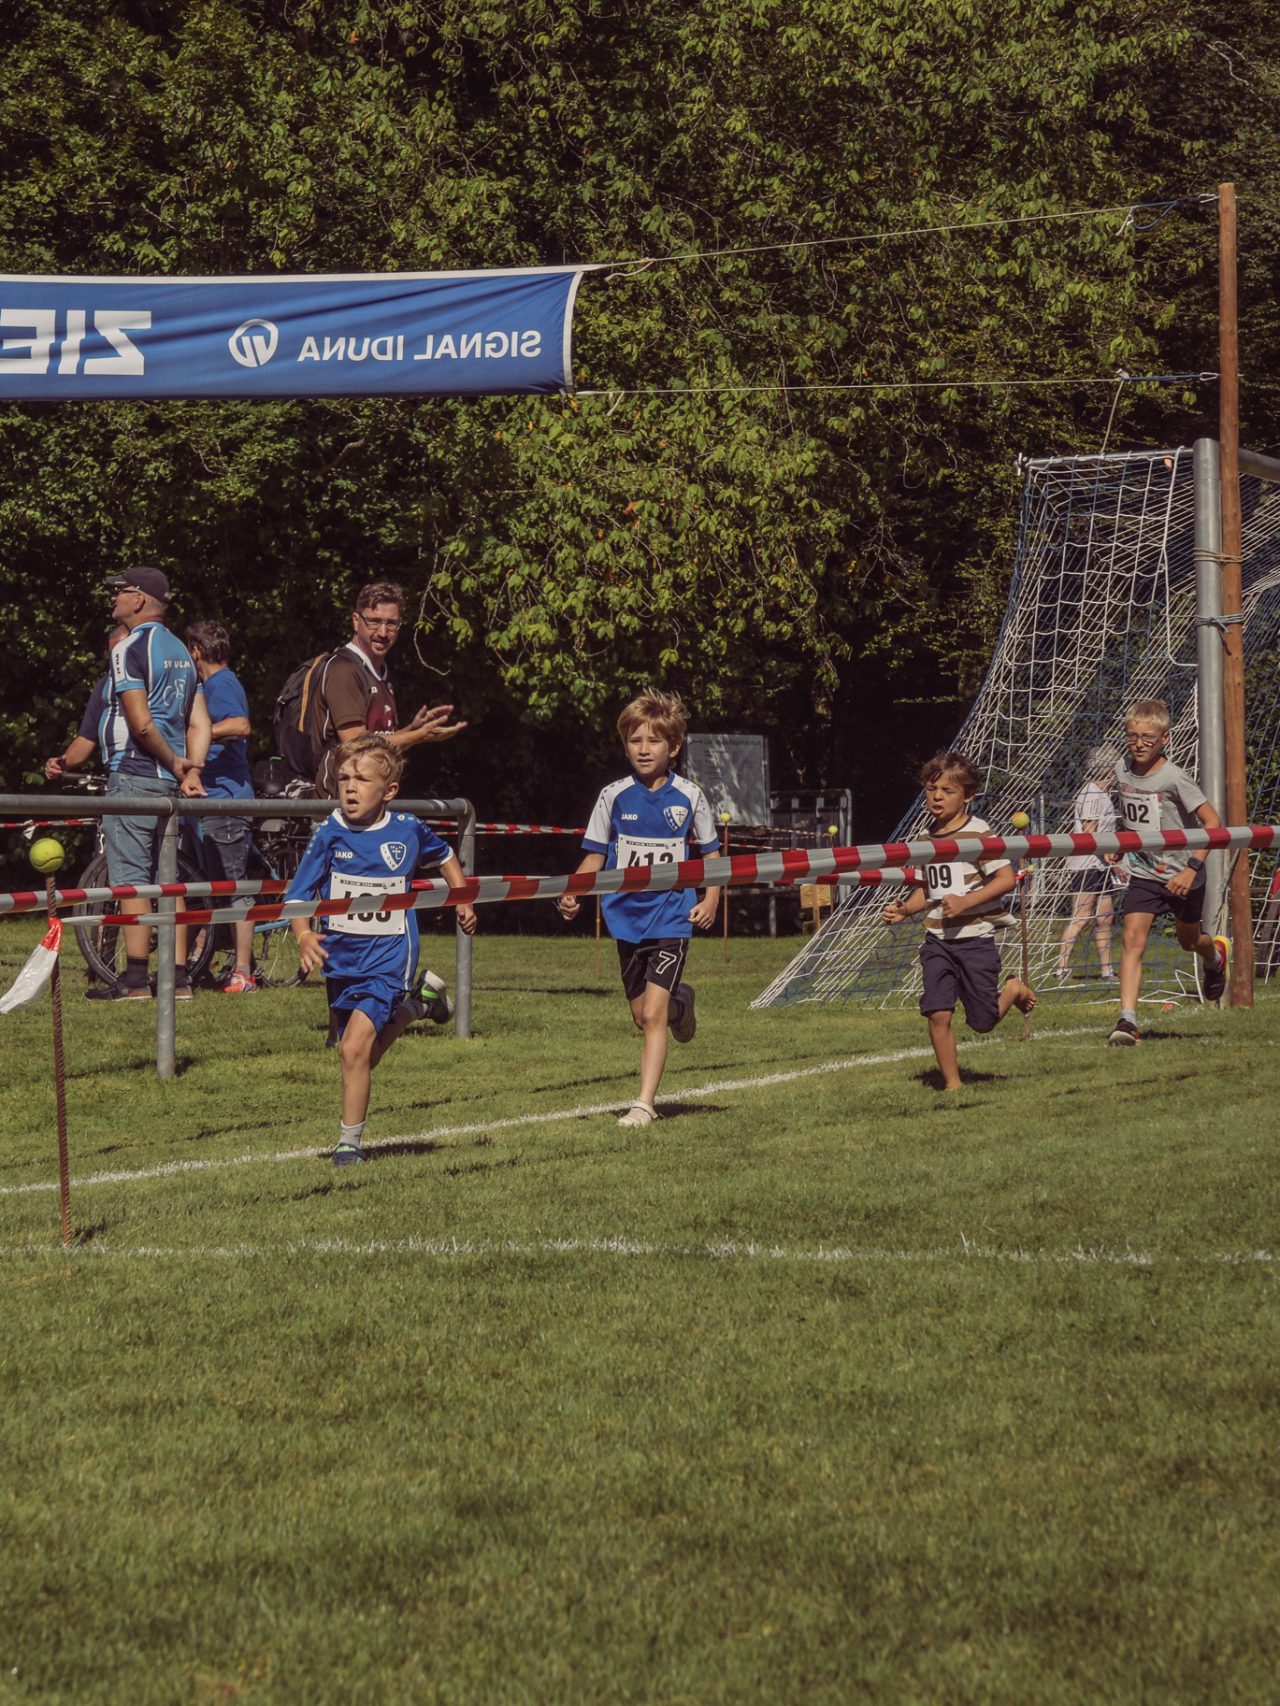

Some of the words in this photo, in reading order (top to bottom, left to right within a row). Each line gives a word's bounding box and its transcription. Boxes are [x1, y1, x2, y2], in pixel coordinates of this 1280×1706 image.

[173, 660, 192, 669] ULM
[621, 813, 639, 821] JAKO
[335, 850, 354, 859] JAKO
[927, 864, 953, 890] 09
[655, 950, 678, 975] 7
